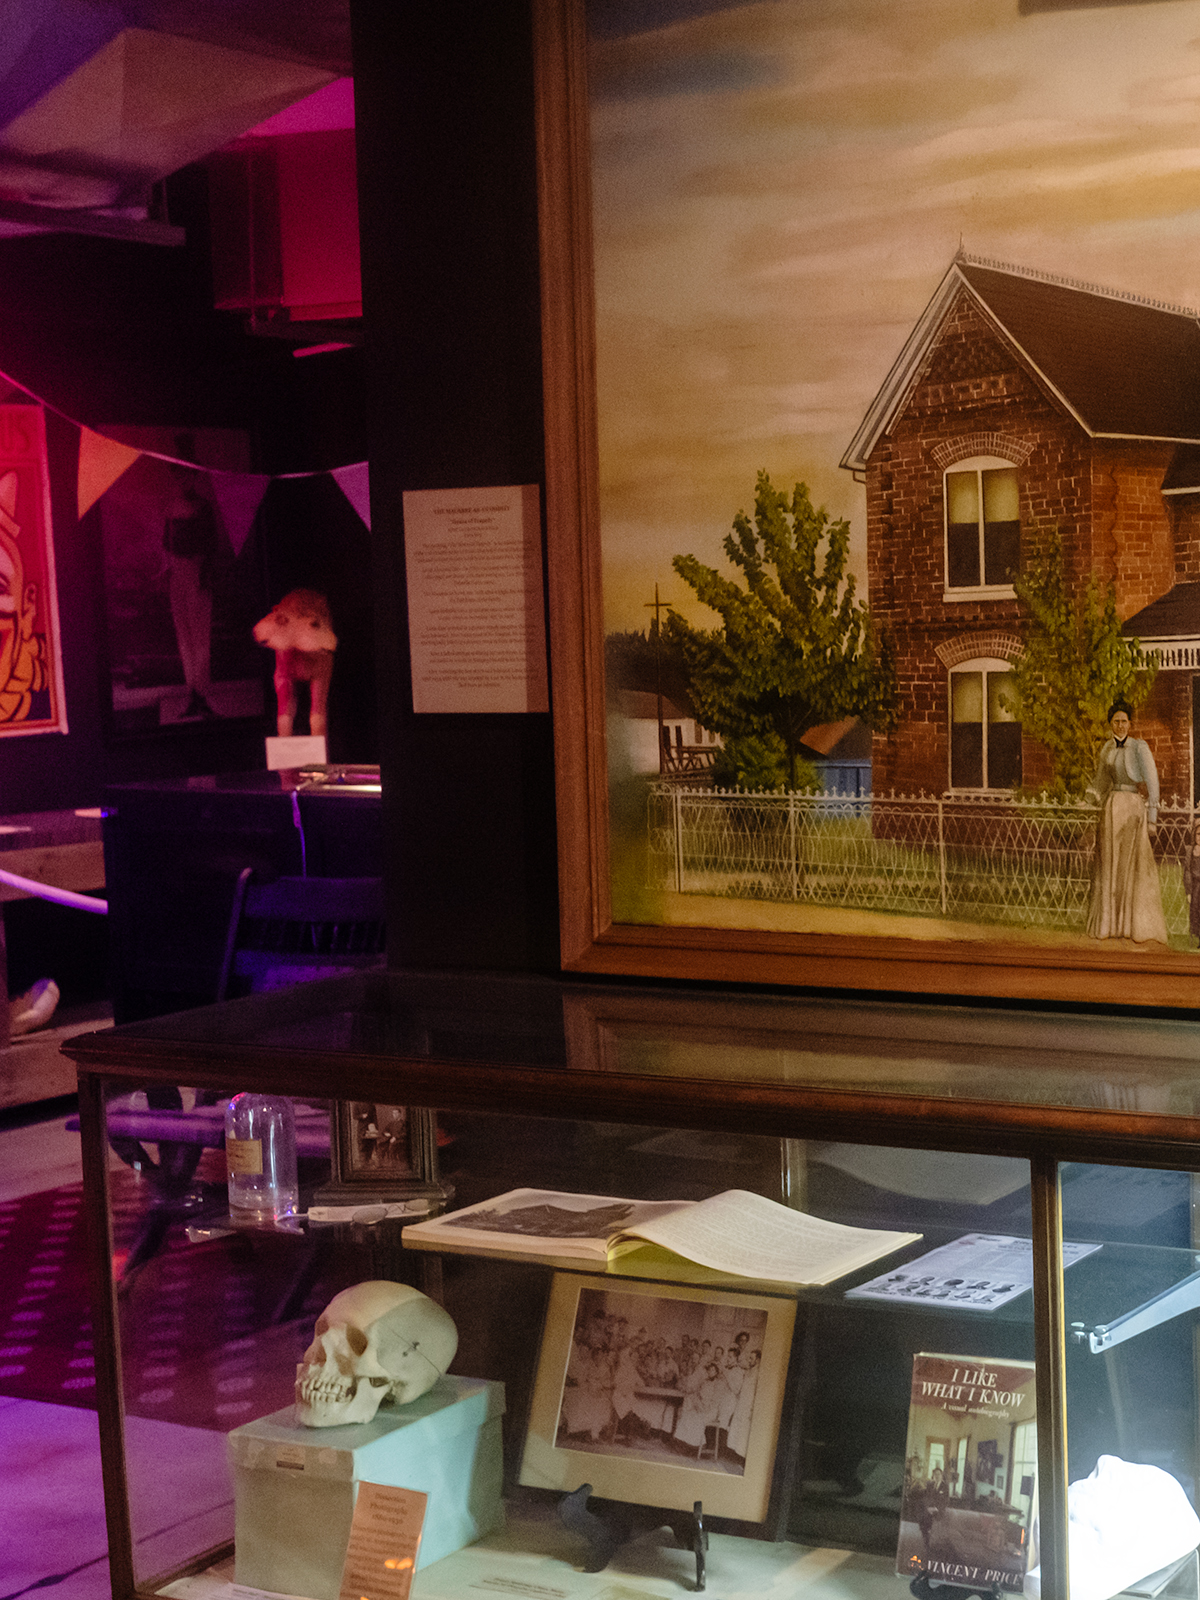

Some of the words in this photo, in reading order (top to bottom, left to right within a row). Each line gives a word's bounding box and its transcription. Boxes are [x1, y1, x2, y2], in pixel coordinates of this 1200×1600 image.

[951, 1368, 959, 1383] I
[962, 1369, 998, 1388] LIKE
[921, 1381, 965, 1400] WHAT
[967, 1387, 976, 1402] I
[979, 1388, 1025, 1408] KNOW
[926, 1560, 980, 1579] VINCENT
[984, 1569, 1021, 1586] PRICE
